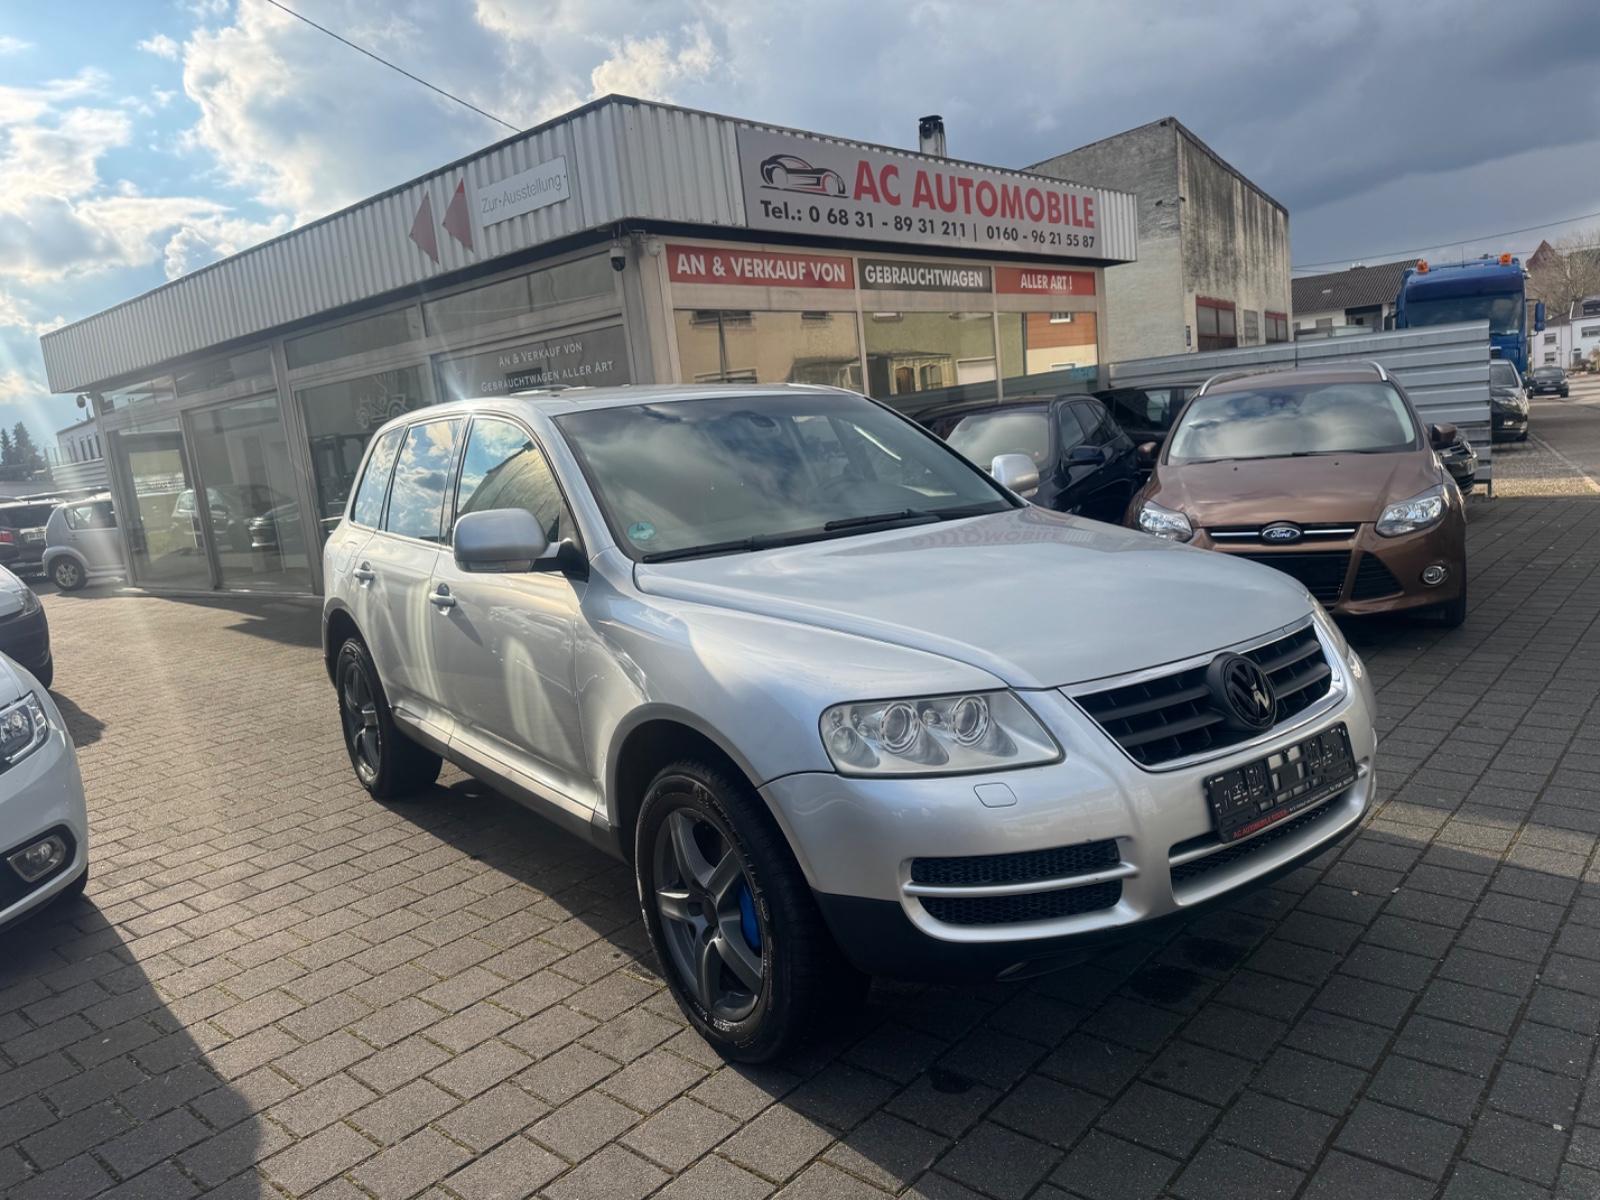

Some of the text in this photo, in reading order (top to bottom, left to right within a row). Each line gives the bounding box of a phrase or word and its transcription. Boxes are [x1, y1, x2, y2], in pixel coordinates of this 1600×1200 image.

[481, 174, 561, 213] Zur Ausstellung
[853, 160, 1095, 229] AC AUTOMOBILE
[760, 200, 802, 221] Tel.:
[809, 205, 820, 223] 0
[827, 207, 849, 226] 68
[855, 211, 874, 228] 31
[894, 215, 913, 232] 89
[918, 217, 935, 234] 31
[941, 221, 966, 237] 211
[986, 225, 1019, 242] 0160
[1031, 230, 1046, 244] 96
[1050, 232, 1061, 245] 21
[1067, 234, 1079, 247] 55
[1083, 236, 1095, 248] 87
[677, 253, 846, 282] AN & VERKAUF VON
[864, 263, 984, 288] GEBRAUCHTWAGEN
[1020, 273, 1048, 289] ALLER
[1050, 275, 1067, 290] ART
[521, 345, 561, 362] VERKAUF
[563, 342, 583, 354] VON
[481, 360, 615, 393] GEBRAUCHTWAGEN ALLER ART
